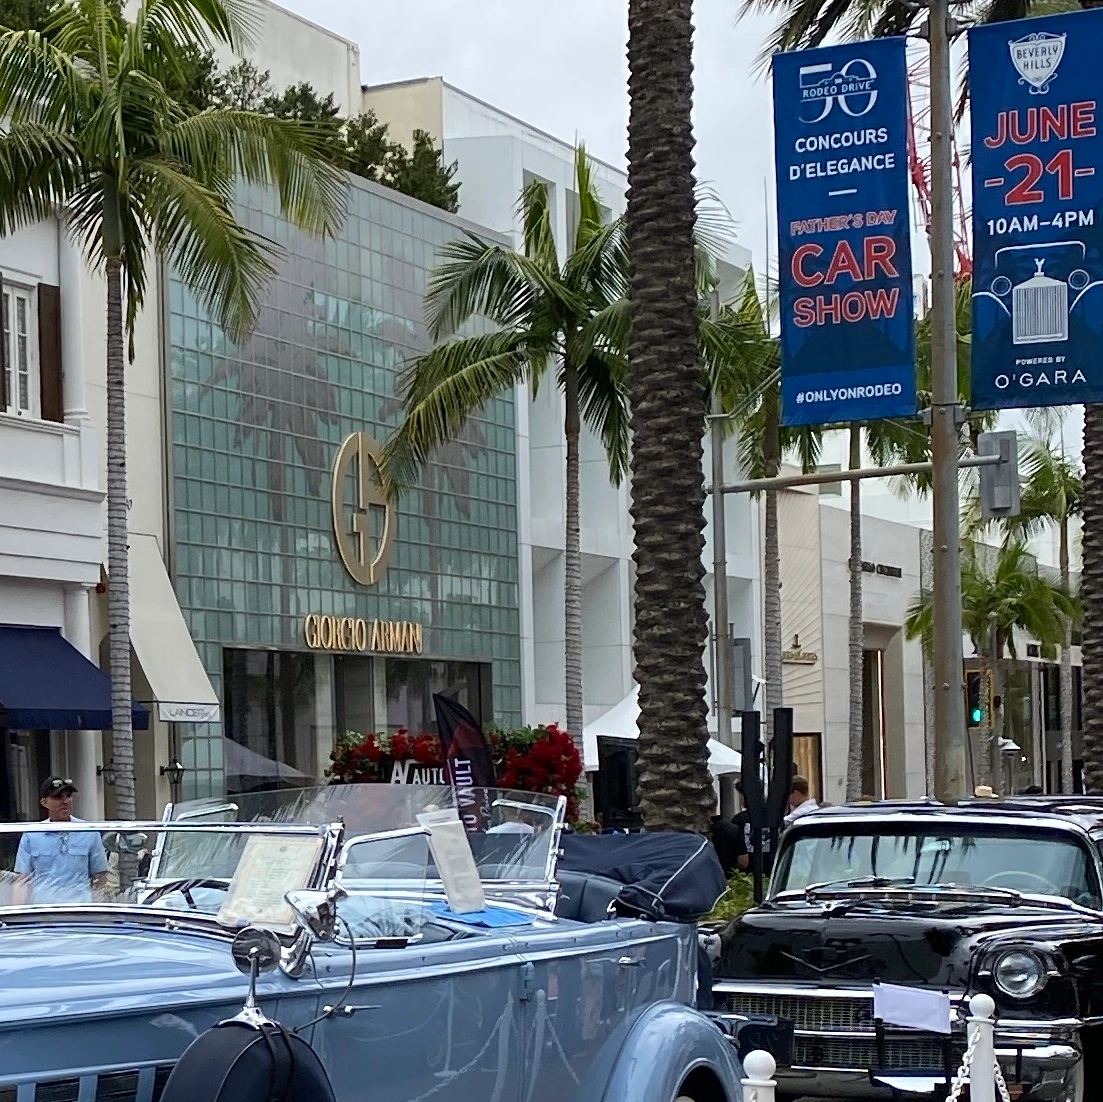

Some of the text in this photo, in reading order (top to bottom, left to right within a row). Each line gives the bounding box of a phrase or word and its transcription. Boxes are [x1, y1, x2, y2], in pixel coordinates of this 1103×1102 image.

[1016, 45, 1058, 60] BEVERLY
[1022, 57, 1052, 71] HILLS
[802, 81, 872, 98] RODEO DRIVE
[983, 101, 1097, 149] JUNE
[794, 127, 889, 153] CONCOURS
[789, 153, 896, 181] D'ELEGANCE
[790, 209, 898, 236] FATHER'S DAY
[791, 235, 900, 288] CAR
[793, 287, 900, 328] SHOW
[1015, 355, 1066, 366] POWERED BY
[995, 369, 1088, 389] O'GARA
[796, 382, 903, 404] #ONLYONRODEO
[304, 613, 423, 654] GIORGIO ARMANI
[454, 758, 476, 808] VAULT
